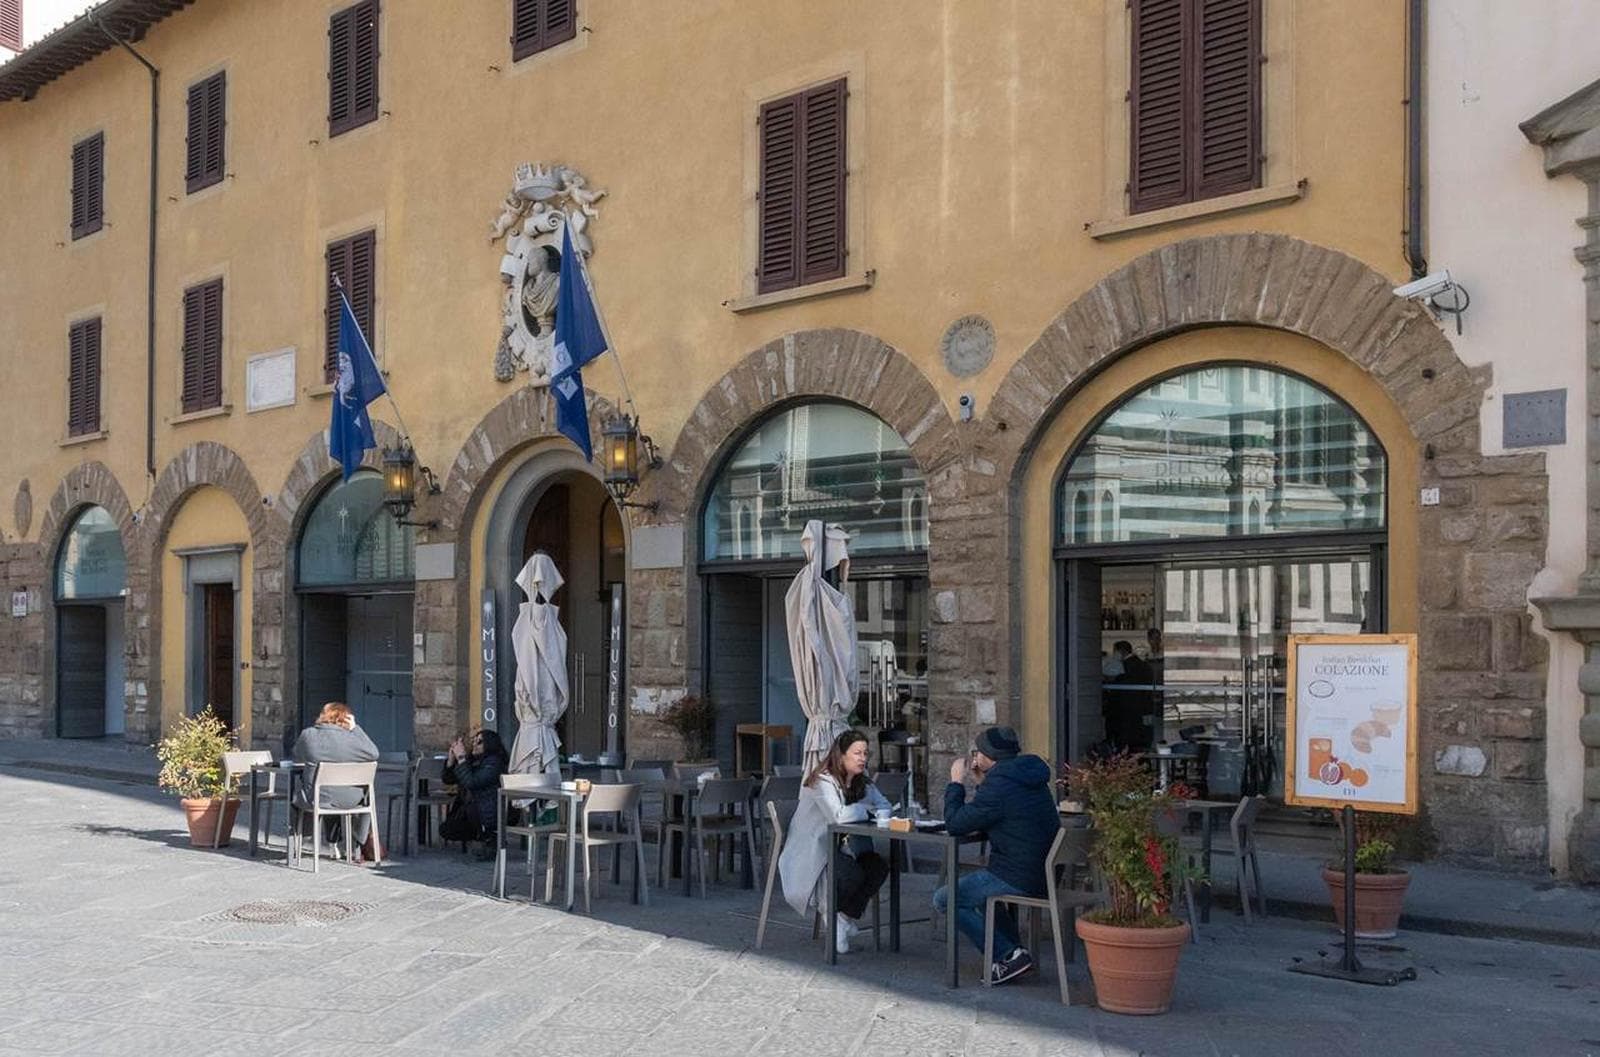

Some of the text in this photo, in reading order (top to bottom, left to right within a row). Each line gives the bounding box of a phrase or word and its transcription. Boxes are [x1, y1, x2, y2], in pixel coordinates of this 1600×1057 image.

[482, 628, 496, 722] MUSEO
[608, 625, 621, 728] MUSEO
[1314, 664, 1390, 677] COLAZIONE
